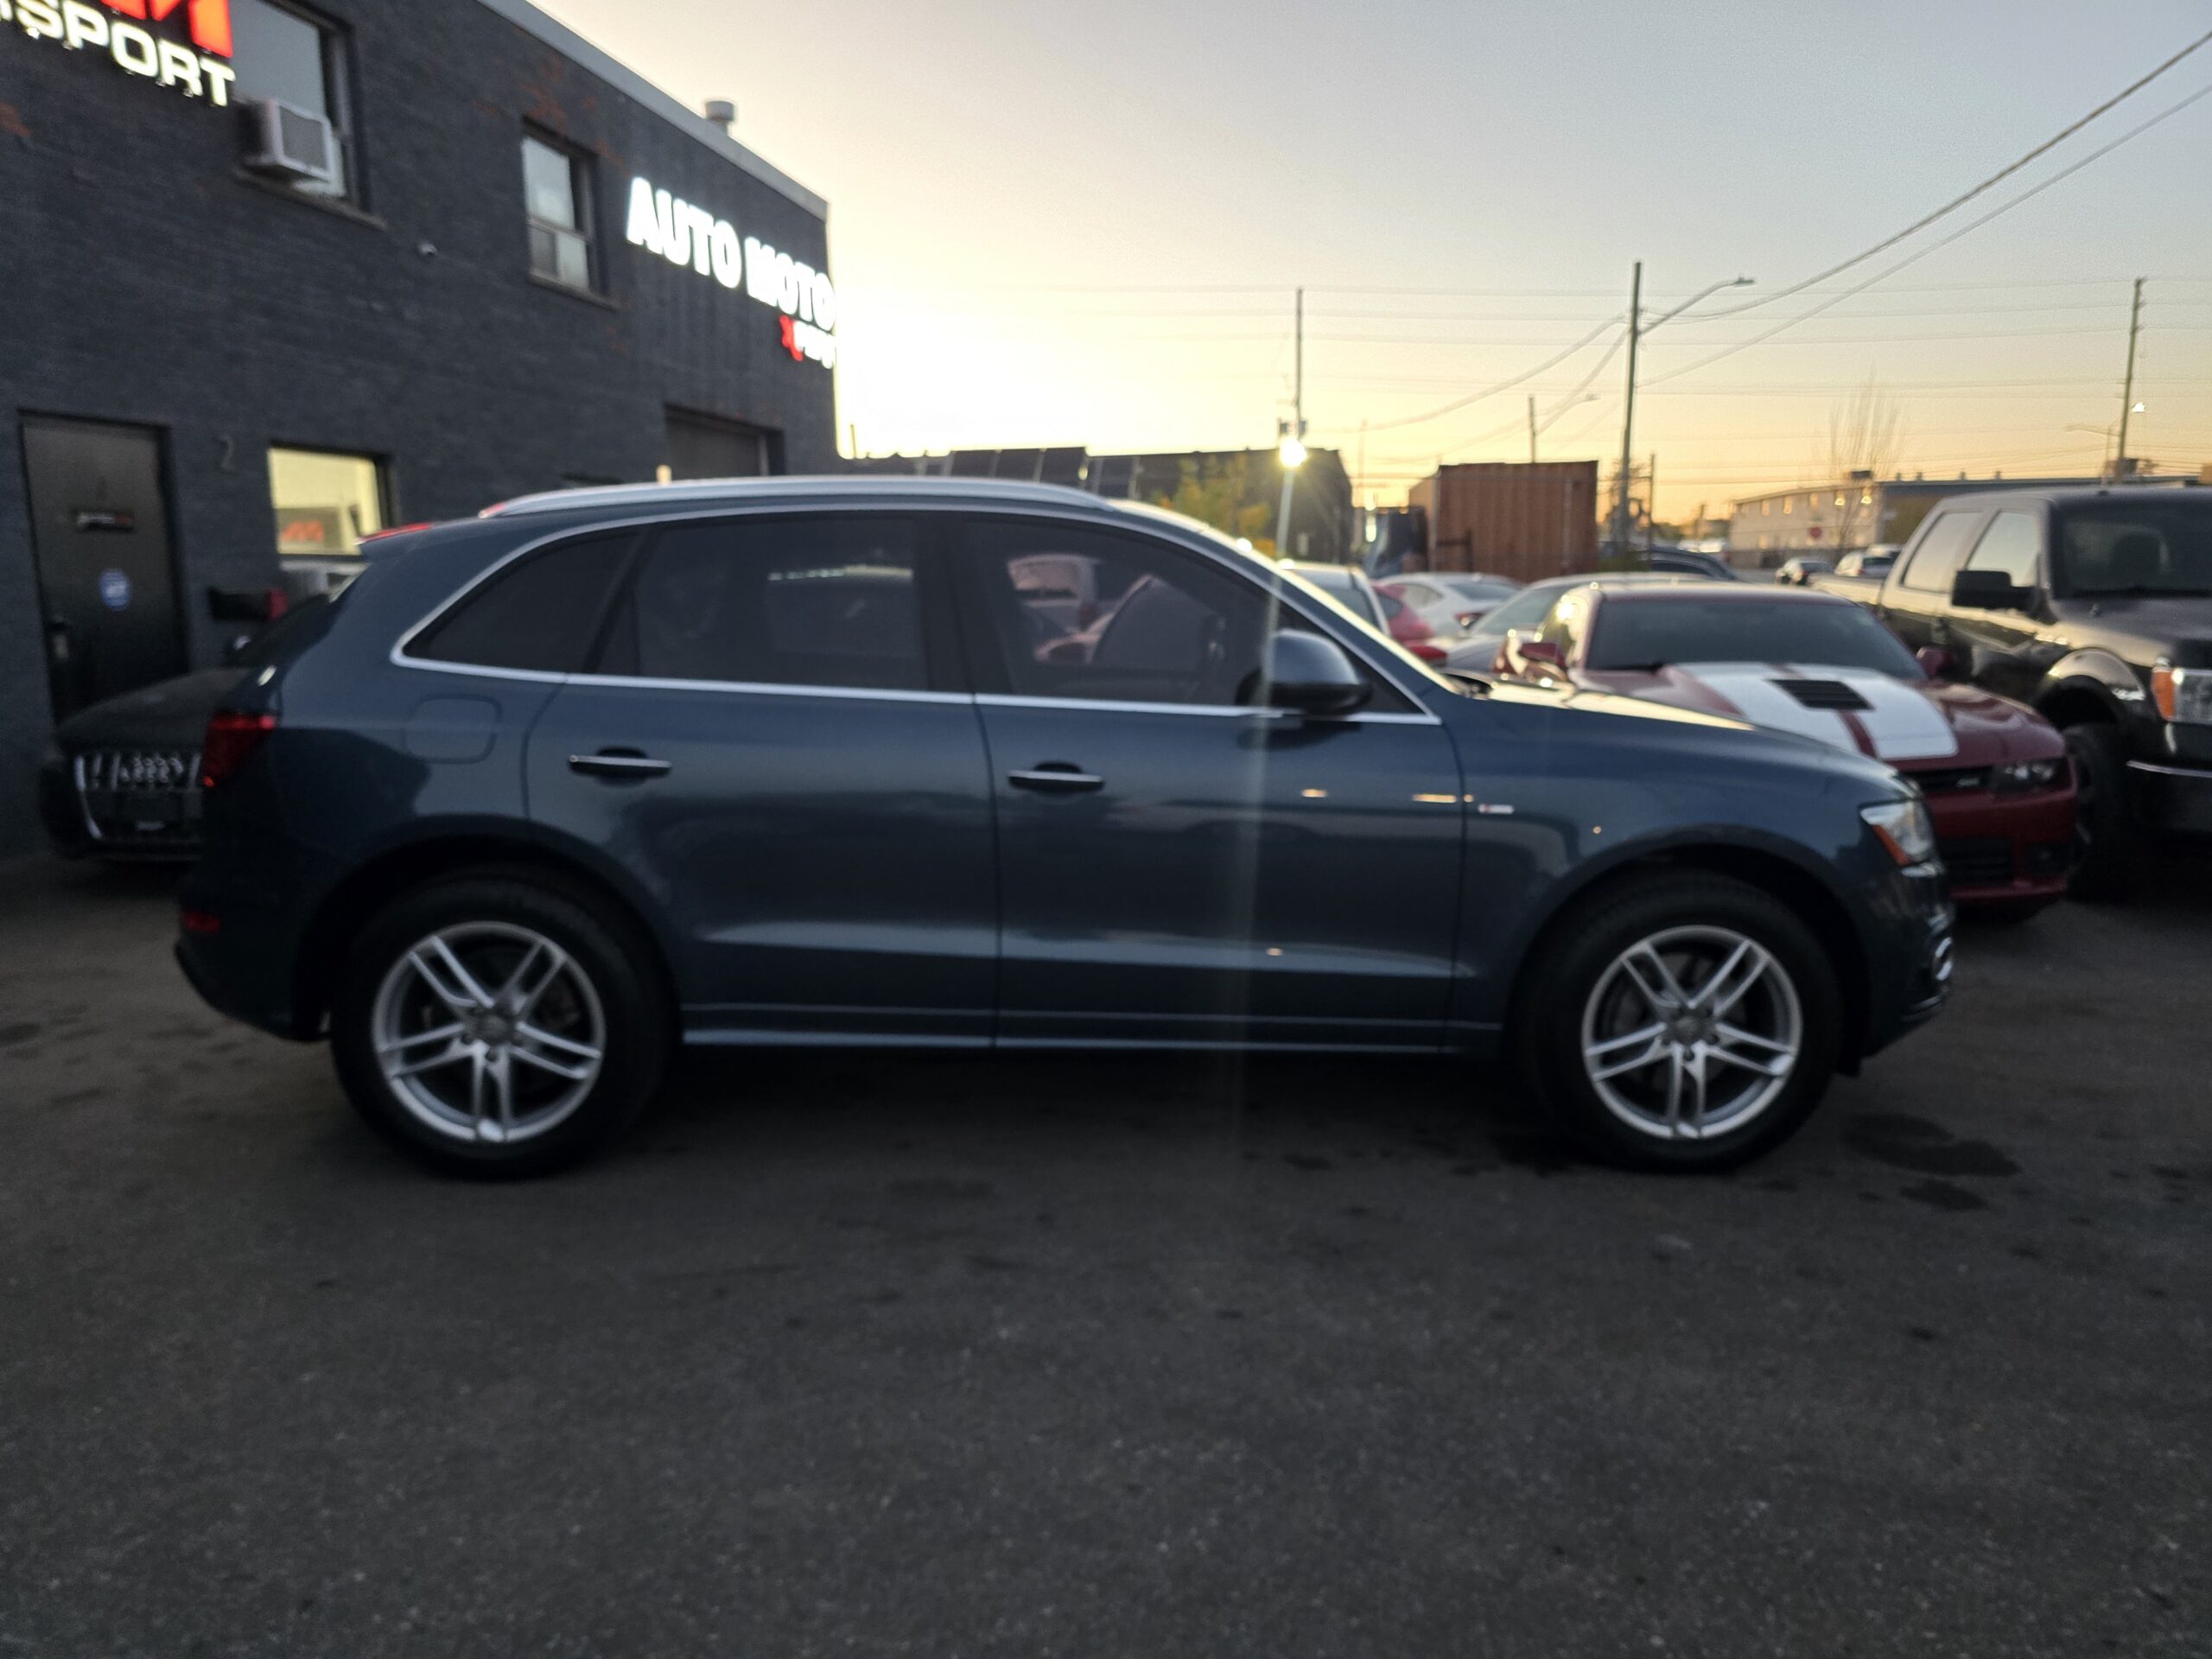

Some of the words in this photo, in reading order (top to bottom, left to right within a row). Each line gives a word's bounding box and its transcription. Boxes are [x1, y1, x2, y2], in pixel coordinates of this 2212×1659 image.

[0, 0, 236, 107] SPORT
[626, 176, 742, 289] AUTO
[744, 236, 836, 332] MOTO
